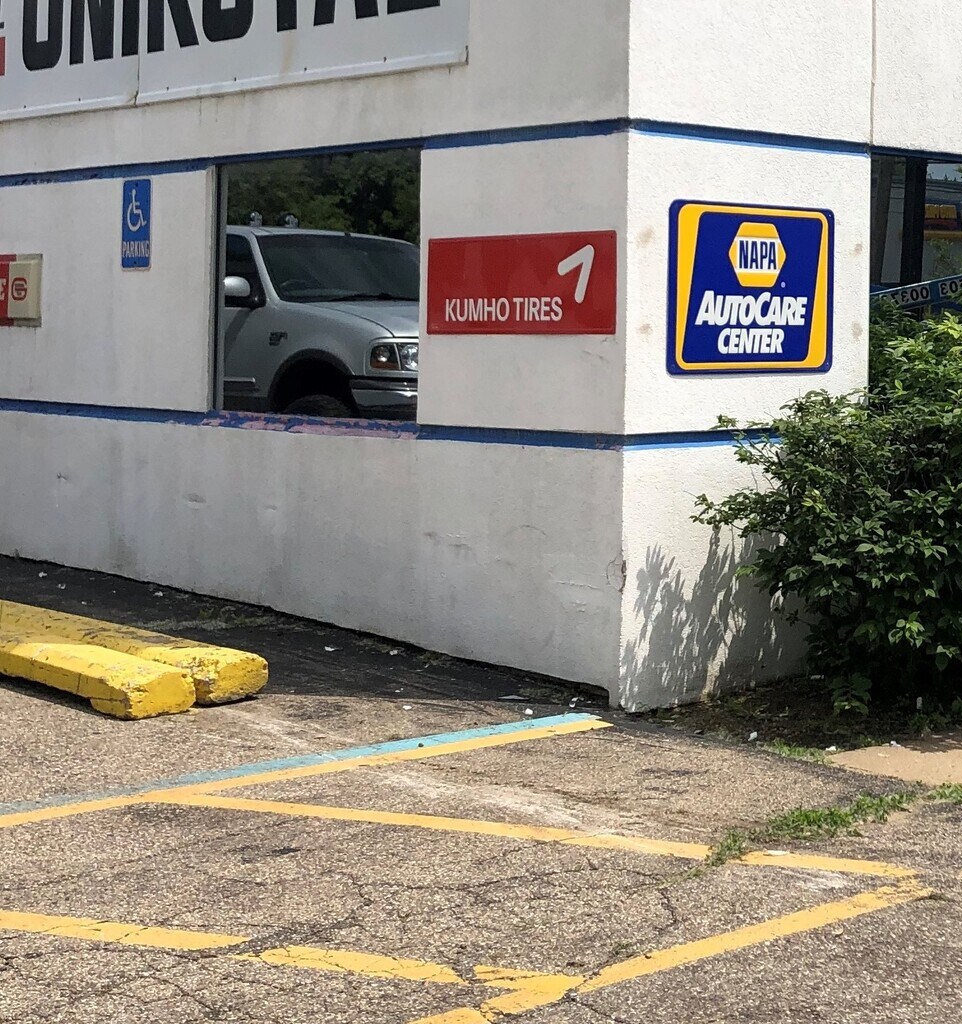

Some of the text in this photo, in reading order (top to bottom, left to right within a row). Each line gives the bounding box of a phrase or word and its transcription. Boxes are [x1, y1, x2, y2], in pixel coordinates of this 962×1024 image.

[122, 241, 150, 258] PARKING
[739, 239, 777, 270] NAPA
[445, 296, 563, 322] KUMHO TIRES
[717, 328, 785, 354] CENTER
